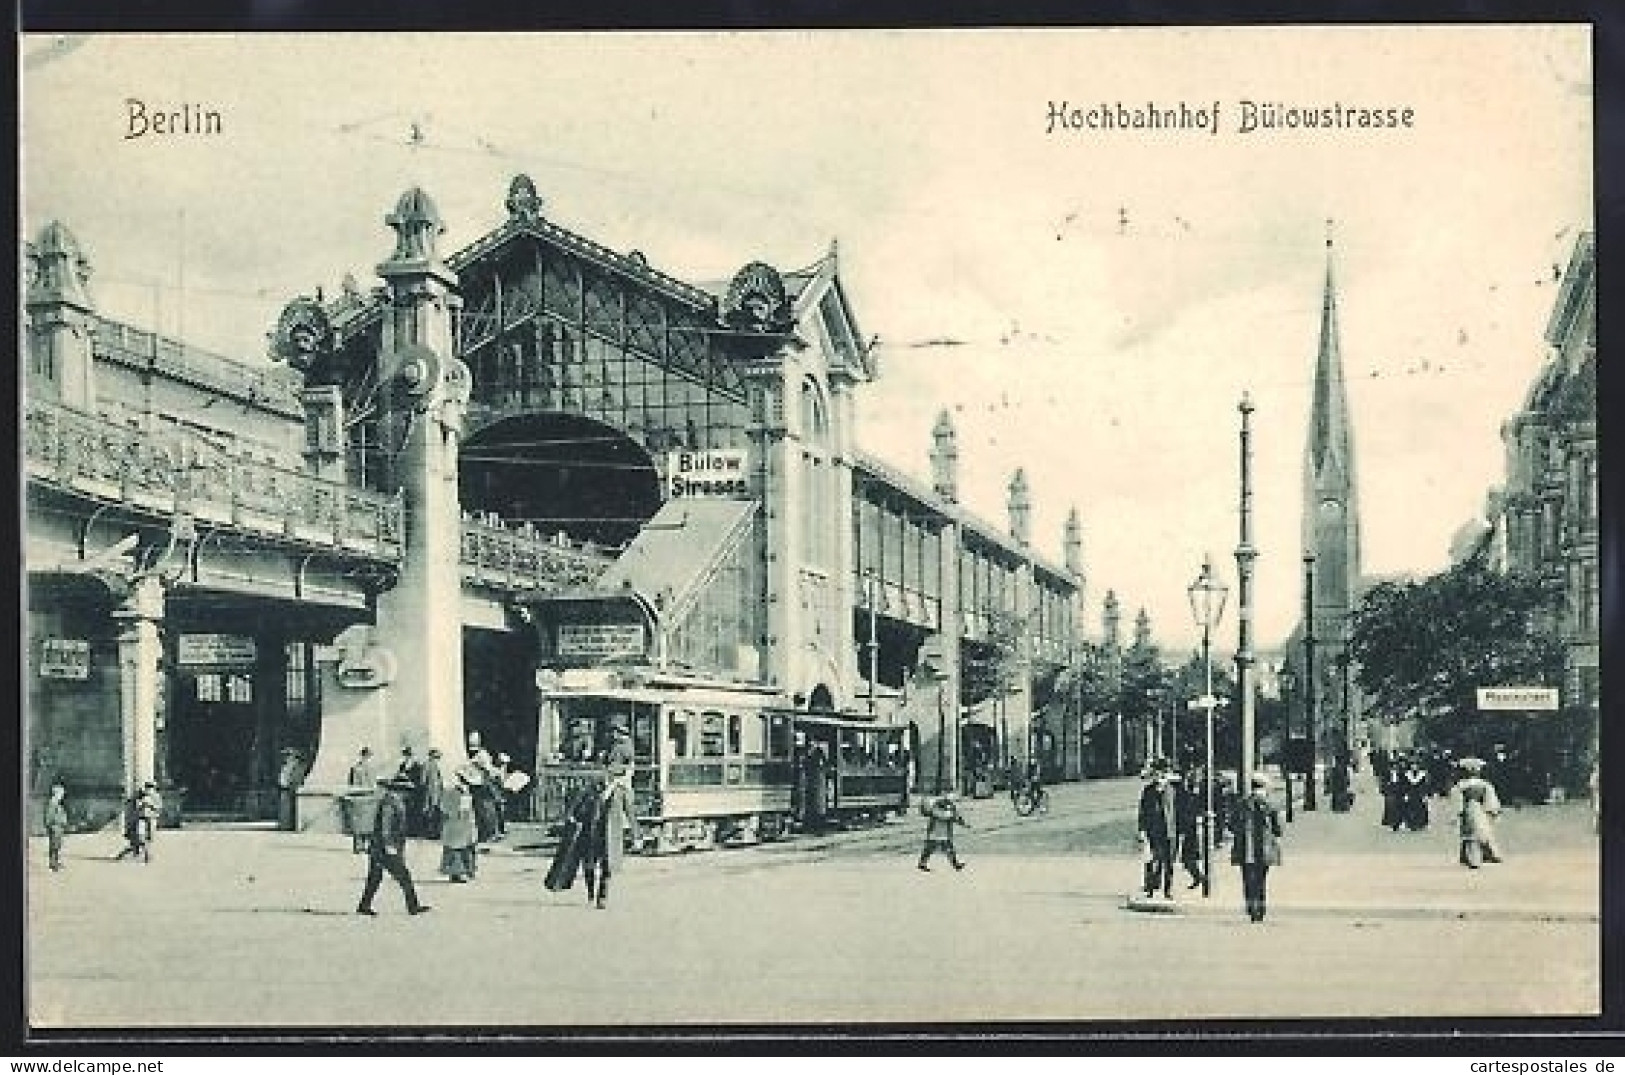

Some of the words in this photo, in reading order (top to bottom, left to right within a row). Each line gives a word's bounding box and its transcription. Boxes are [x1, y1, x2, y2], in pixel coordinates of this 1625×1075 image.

[124, 99, 222, 139] Berlin
[1046, 100, 1220, 134] Hochbahnhof
[1239, 100, 1415, 133] Bülowstrasse
[679, 453, 742, 473] Bülow
